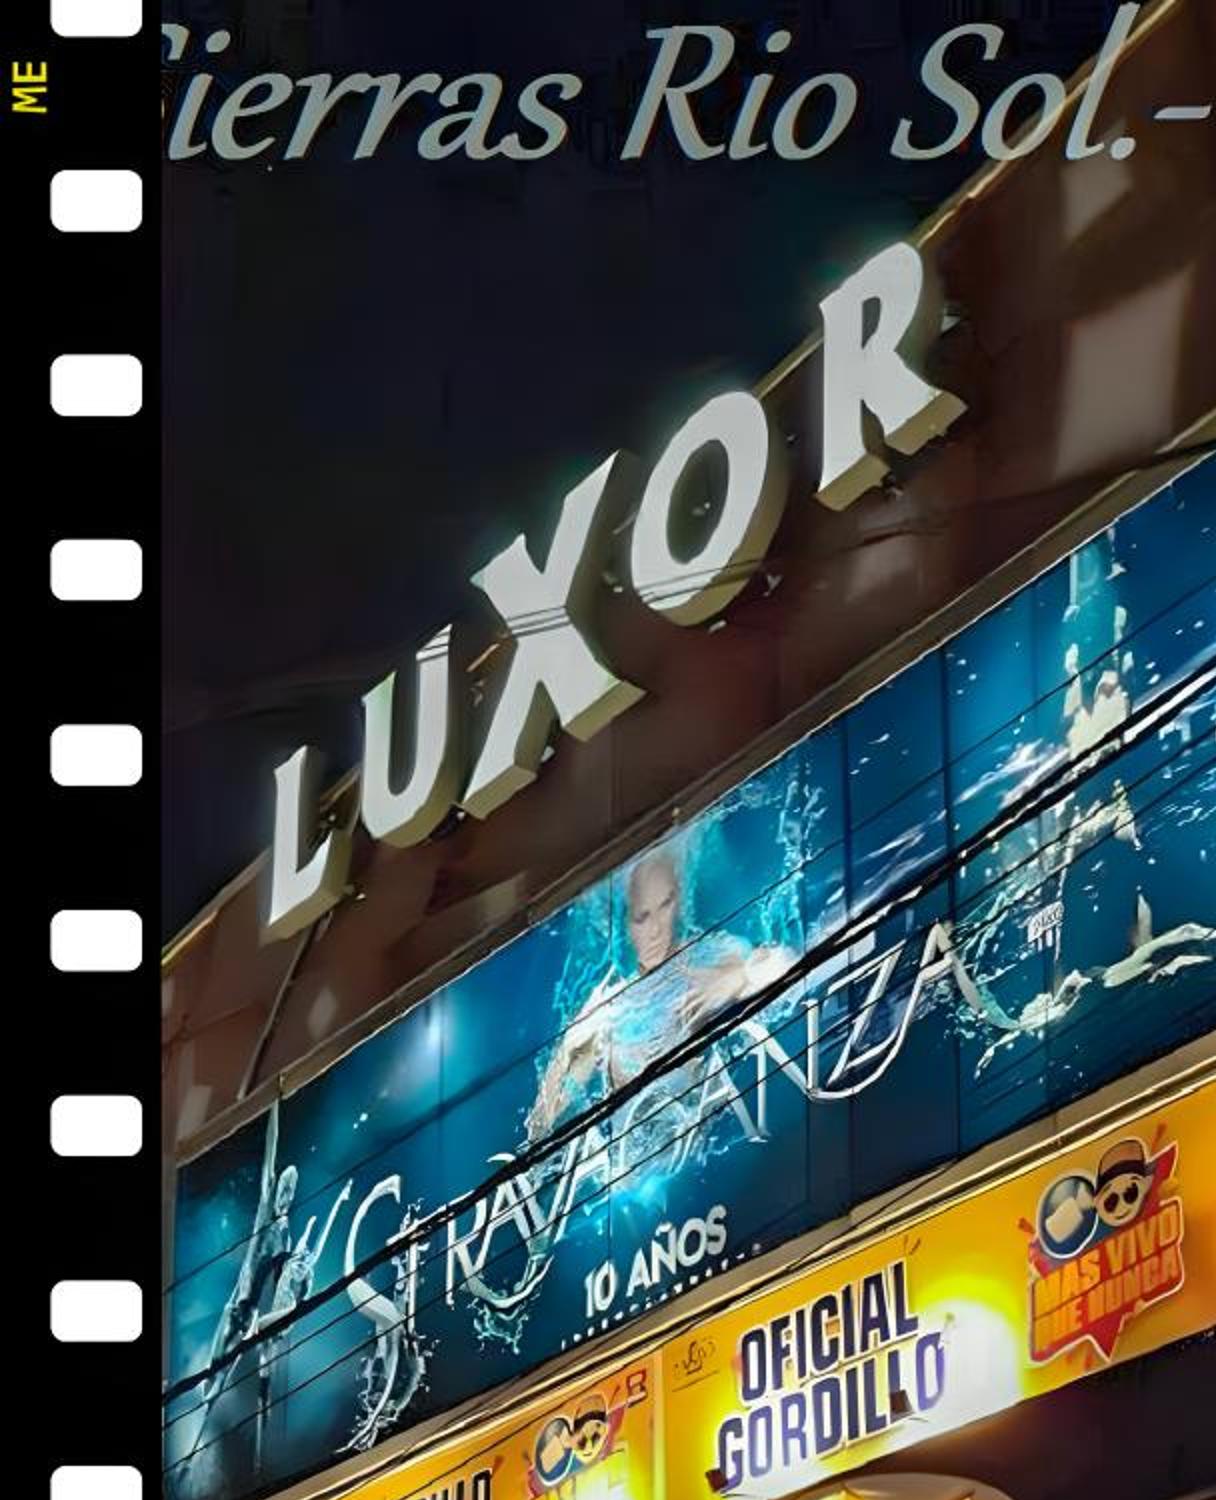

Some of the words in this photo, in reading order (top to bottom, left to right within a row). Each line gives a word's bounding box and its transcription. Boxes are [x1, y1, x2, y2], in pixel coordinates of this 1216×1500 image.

[266, 241, 964, 932] LUXOR
[584, 1260, 618, 1319] 10
[625, 1204, 728, 1297] AÑOS
[741, 1260, 919, 1402] OFICIAL
[717, 1331, 945, 1495] GORDILLO
